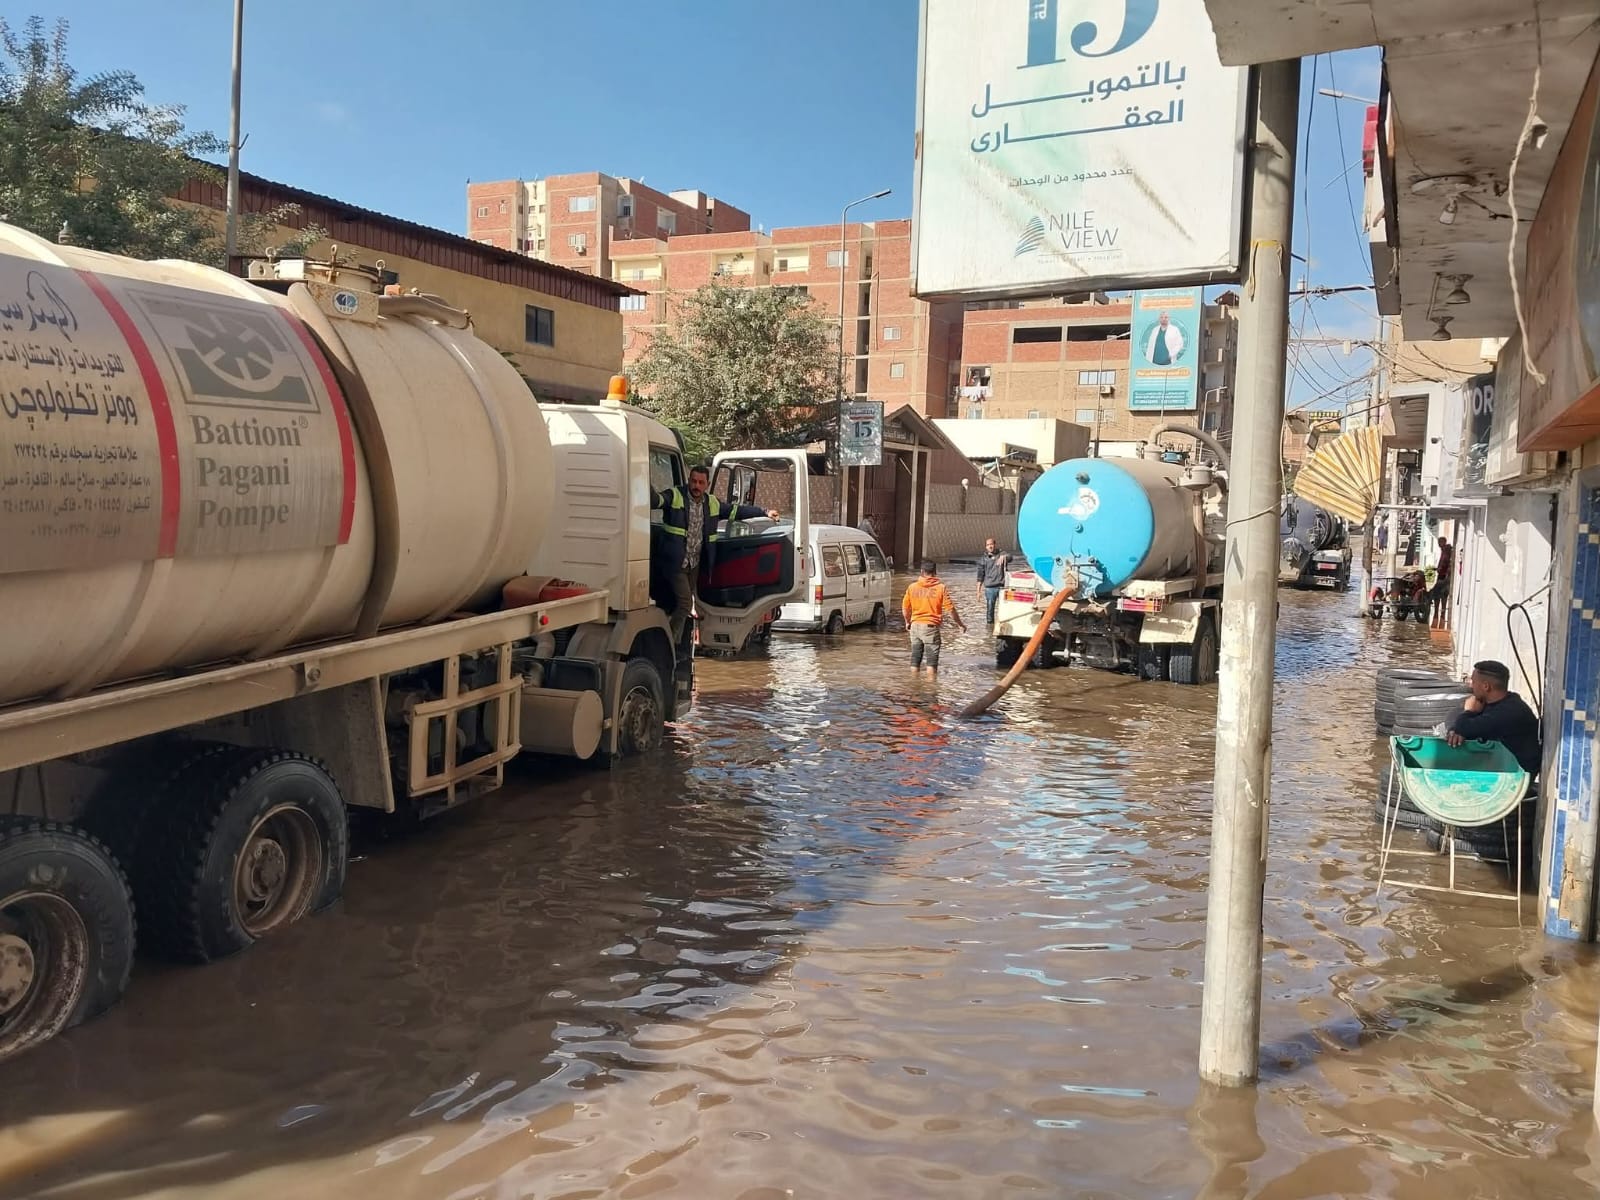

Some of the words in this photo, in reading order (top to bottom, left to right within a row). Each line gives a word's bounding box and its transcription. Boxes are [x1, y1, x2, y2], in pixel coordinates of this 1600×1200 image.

[970, 61, 1186, 118] بالتمويل
[1054, 174, 1069, 184] من
[1072, 170, 1107, 182] محدود
[1110, 168, 1133, 176] عدد
[1049, 210, 1095, 231] NILE
[1060, 228, 1119, 249] VIEW
[851, 421, 873, 438] 15
[196, 457, 290, 495] Pagani
[198, 499, 290, 534] Pompe
